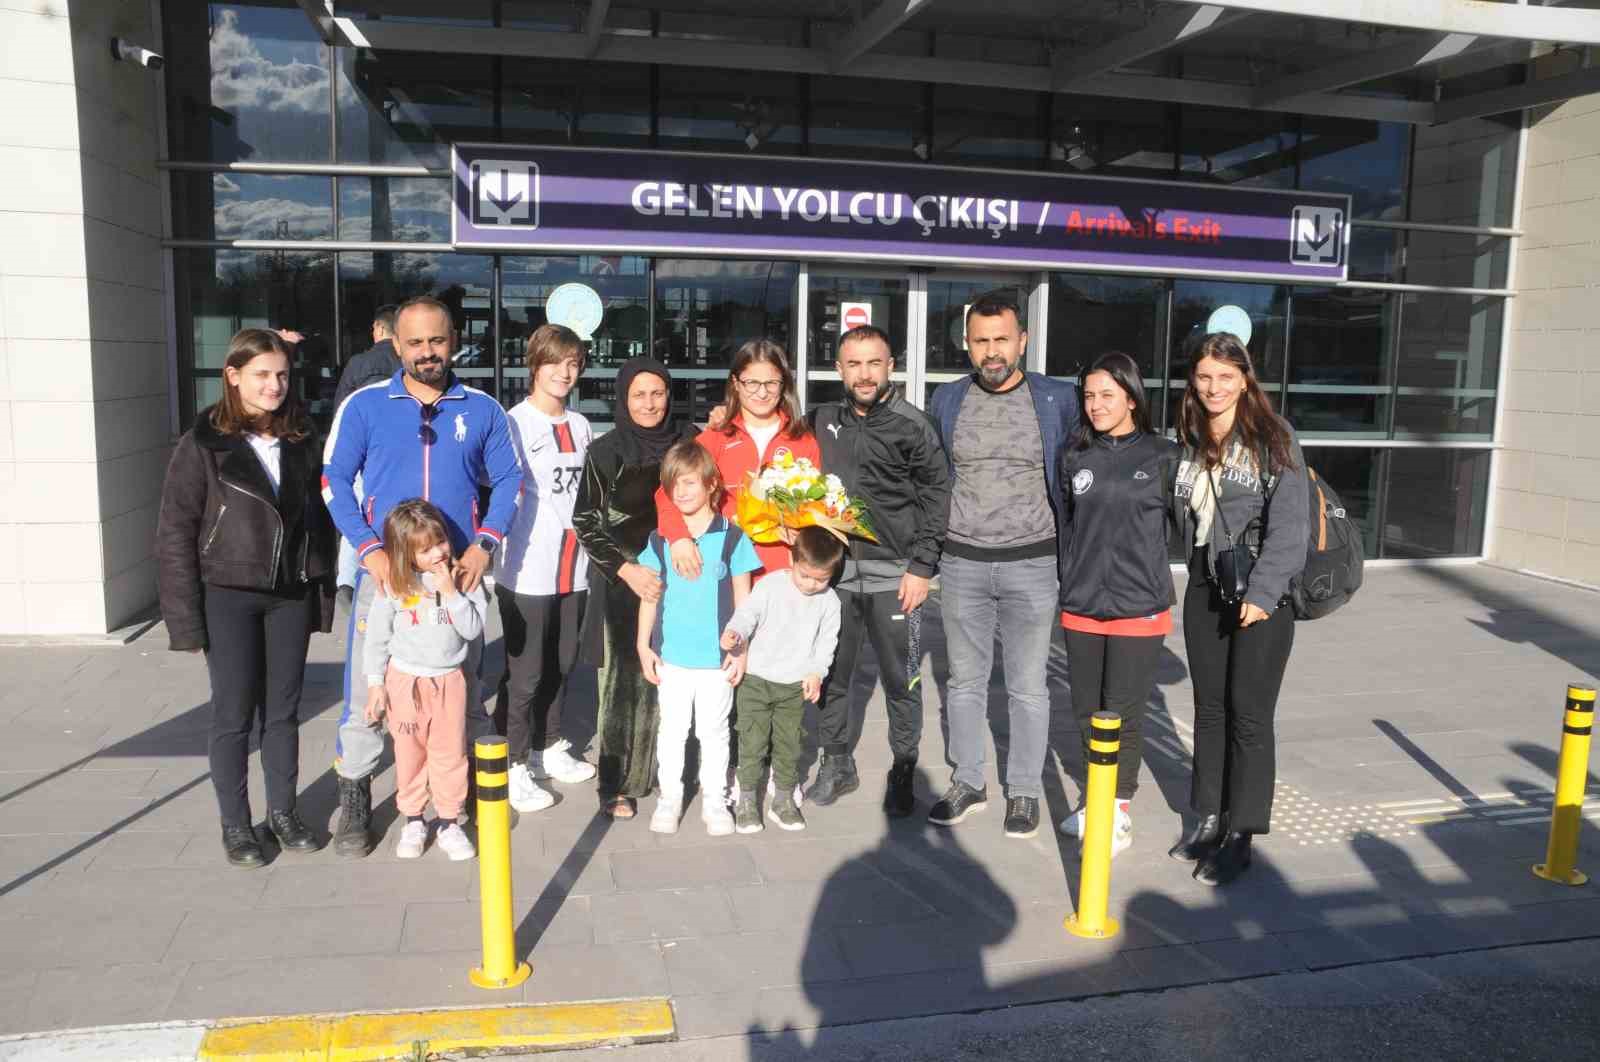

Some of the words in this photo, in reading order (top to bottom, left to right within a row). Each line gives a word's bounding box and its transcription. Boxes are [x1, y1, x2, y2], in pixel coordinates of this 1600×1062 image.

[631, 182, 763, 219] GELEN
[772, 187, 902, 225] YOLCU
[912, 195, 1019, 239] ÇIKIŞI
[1066, 209, 1168, 240] Arrivals
[1172, 216, 1223, 245] Exit
